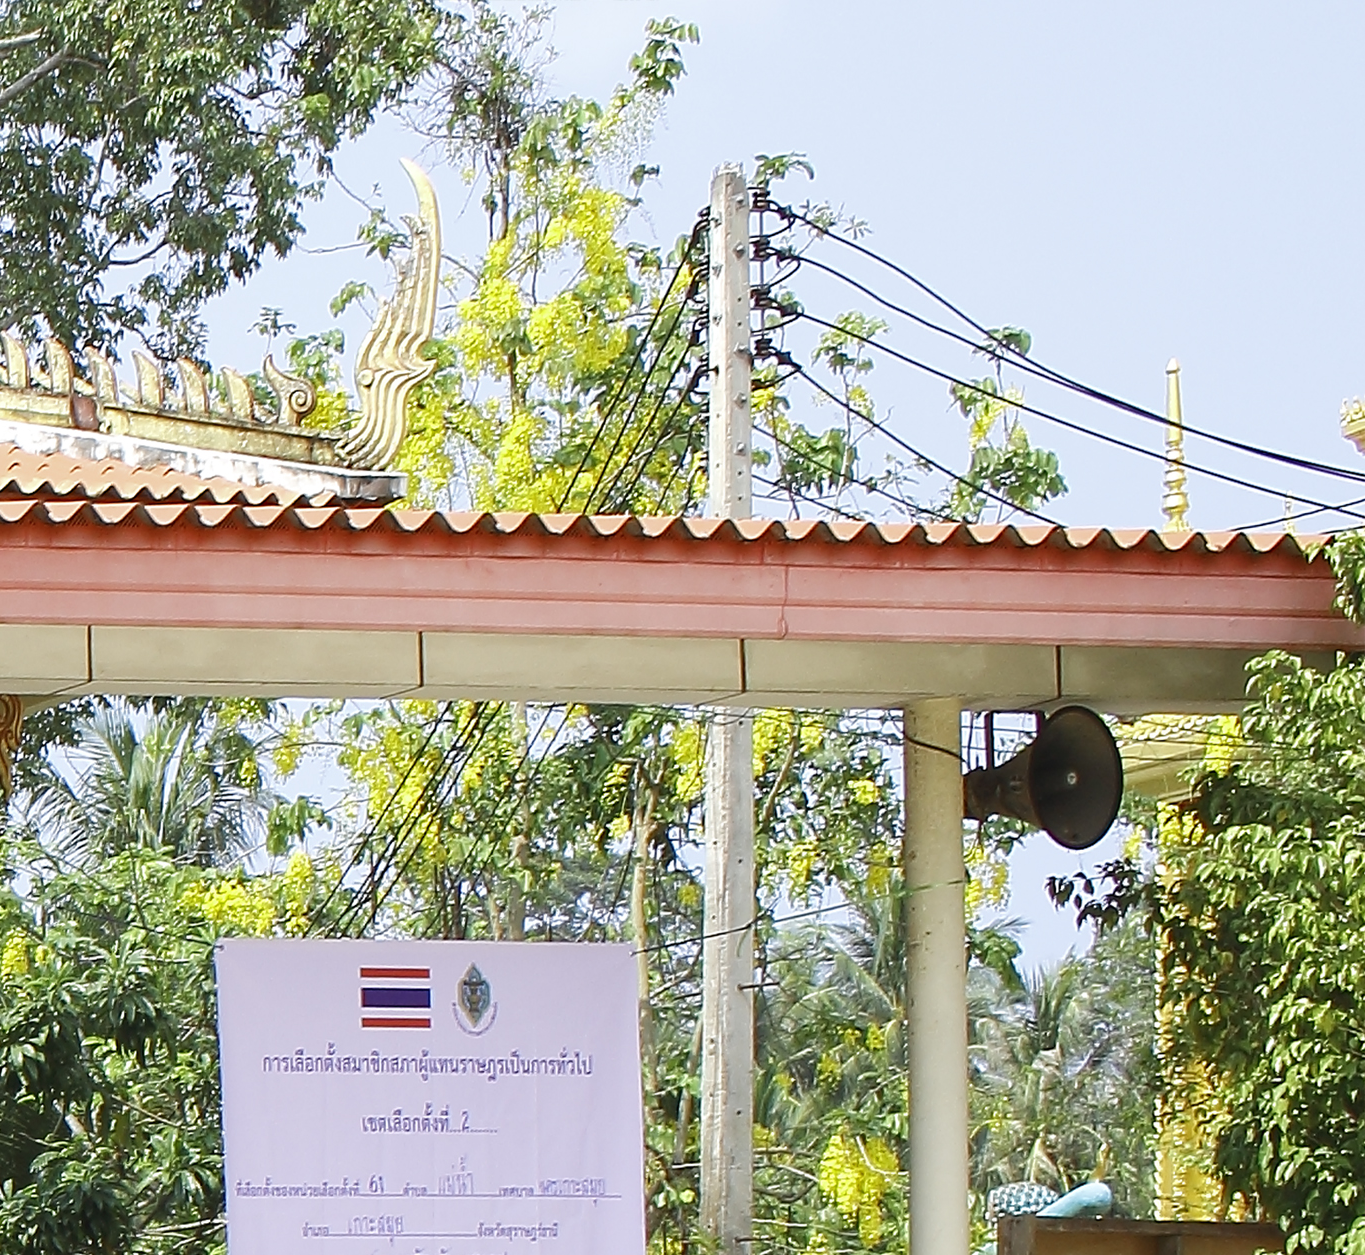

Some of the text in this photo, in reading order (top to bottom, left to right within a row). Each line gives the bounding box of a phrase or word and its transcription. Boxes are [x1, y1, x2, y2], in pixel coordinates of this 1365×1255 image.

[262, 1042, 593, 1082] การเลือกตั้งสมาชิกสภาผู้แทนราษฎรเป็นการทั่วไป
[361, 1101, 450, 1133] เขตเลือกตั้งที่
